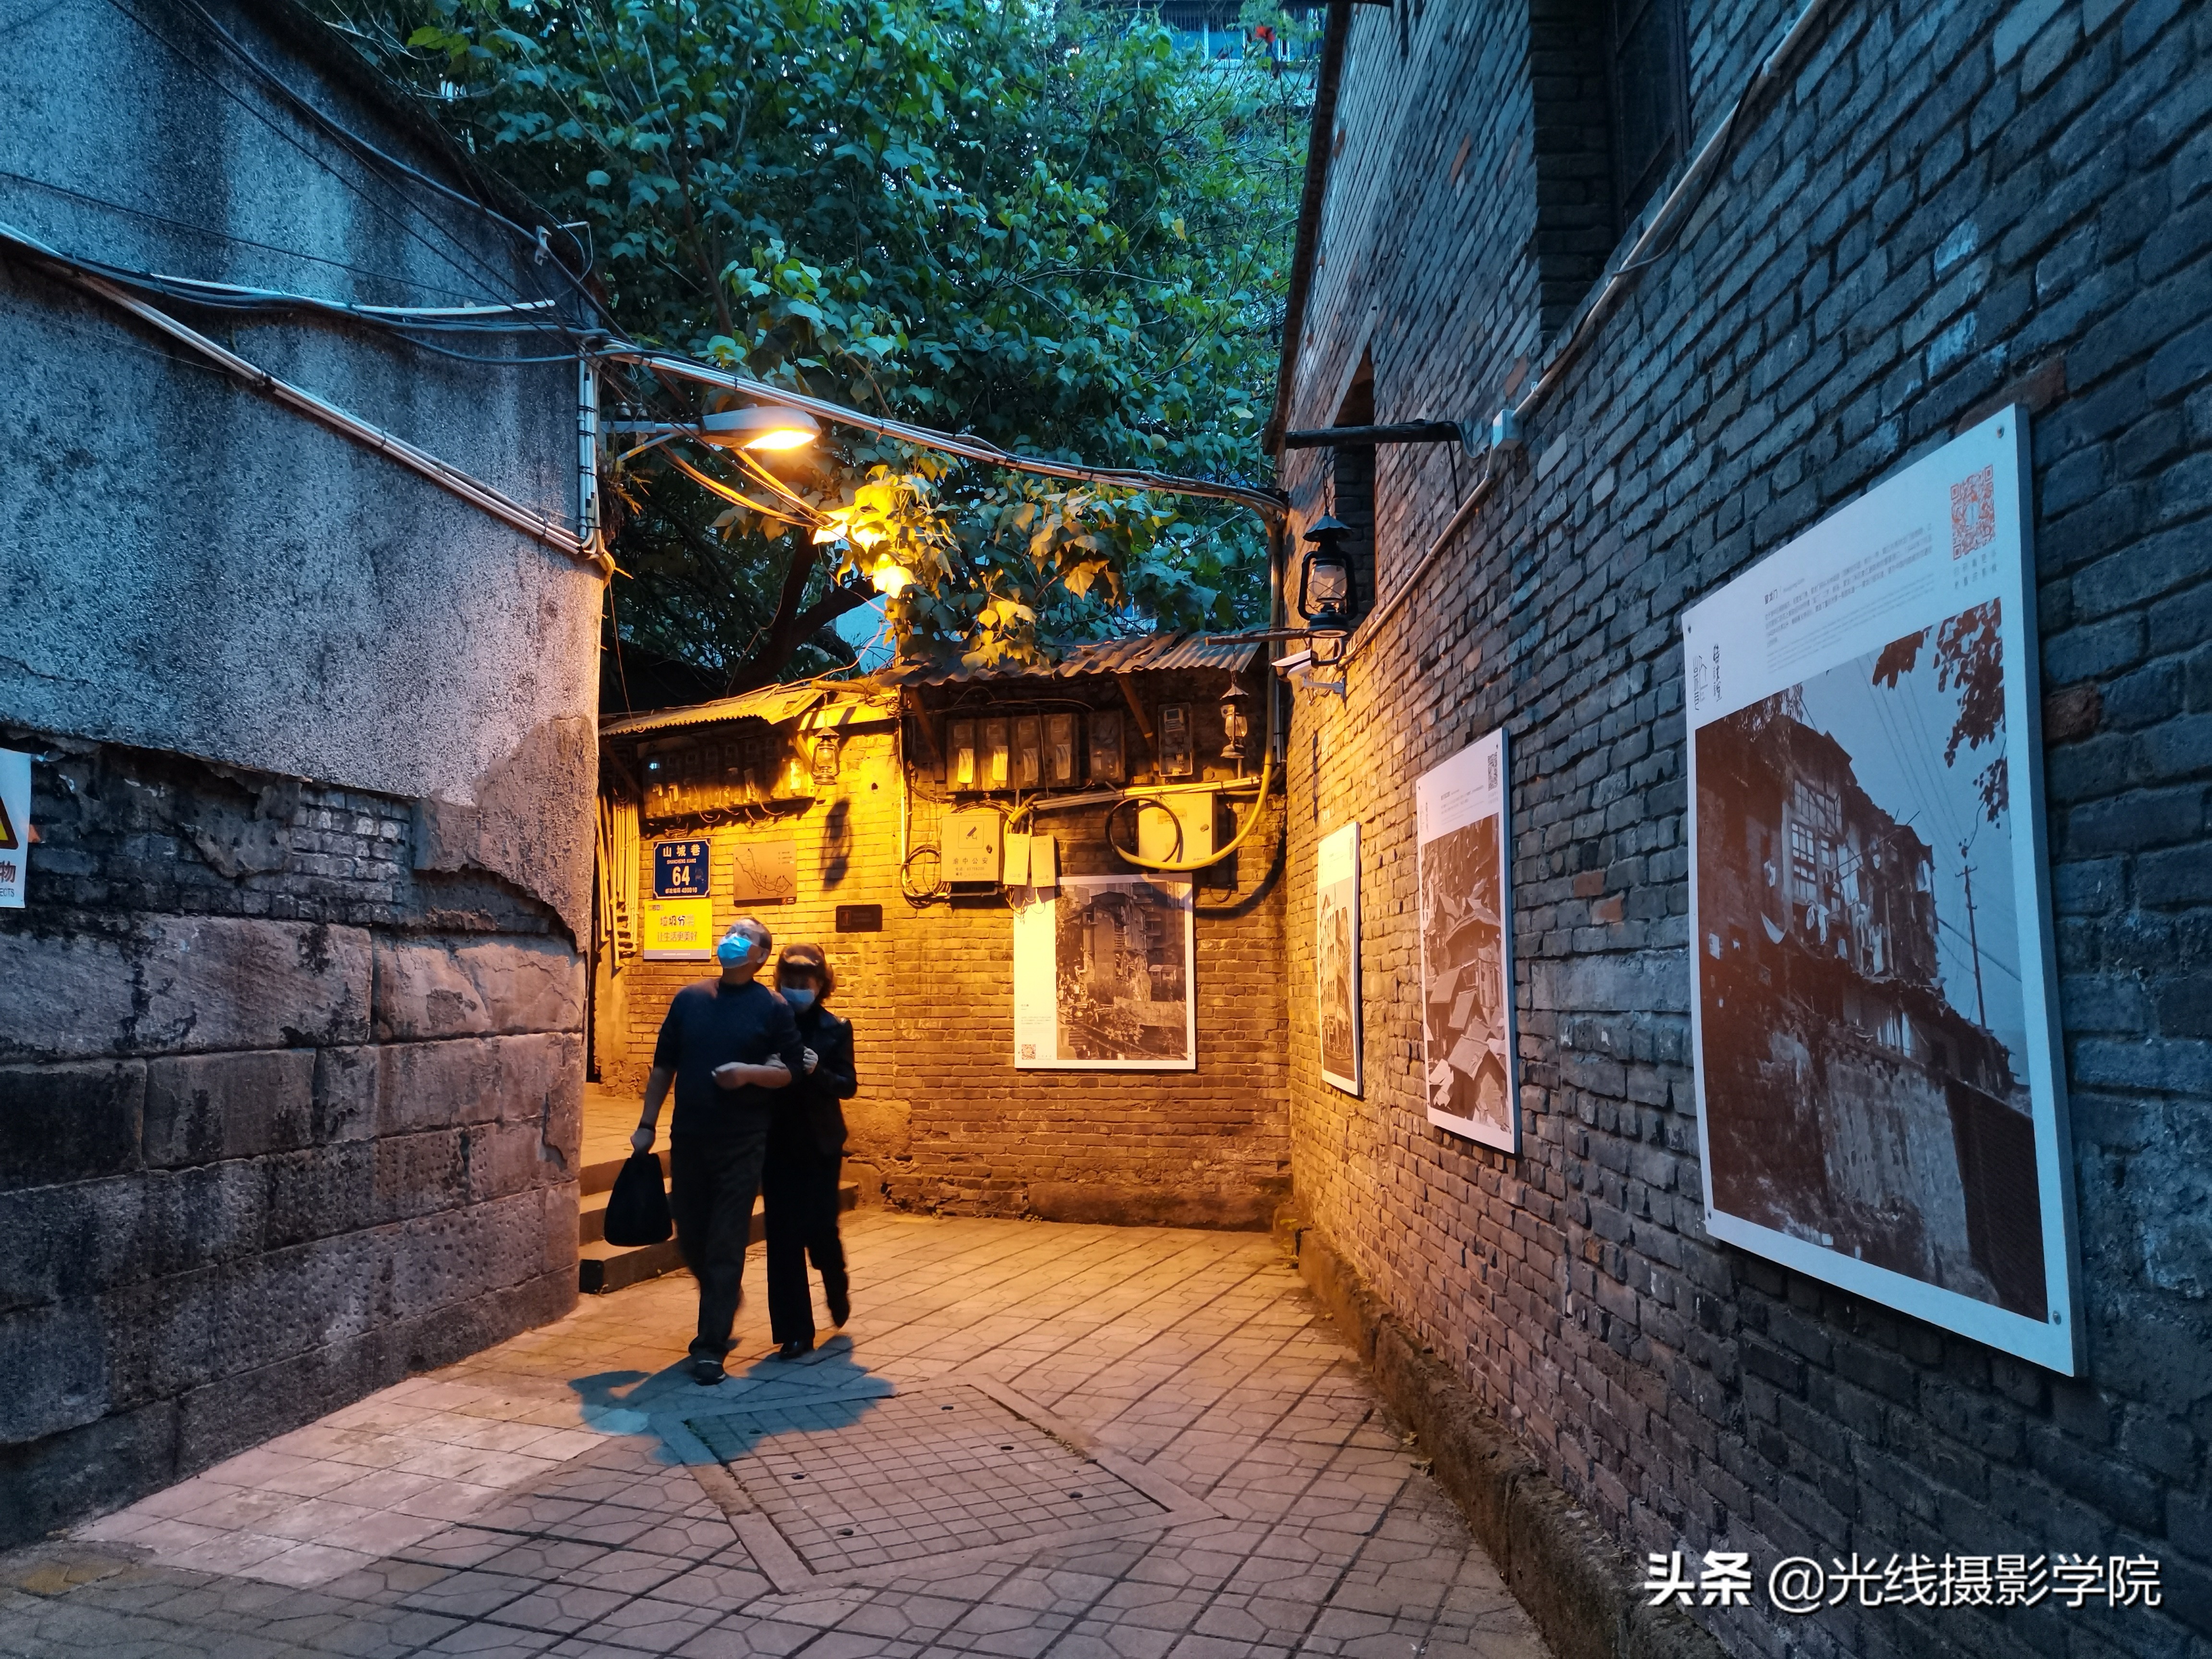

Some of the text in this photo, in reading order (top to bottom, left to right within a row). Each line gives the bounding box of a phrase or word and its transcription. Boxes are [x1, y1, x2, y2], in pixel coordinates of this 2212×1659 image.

[662, 844, 700, 857] 山城巷
[673, 865, 690, 886] 64
[660, 914, 695, 927] 垃圾分类
[657, 932, 697, 942] 让生活更美好
